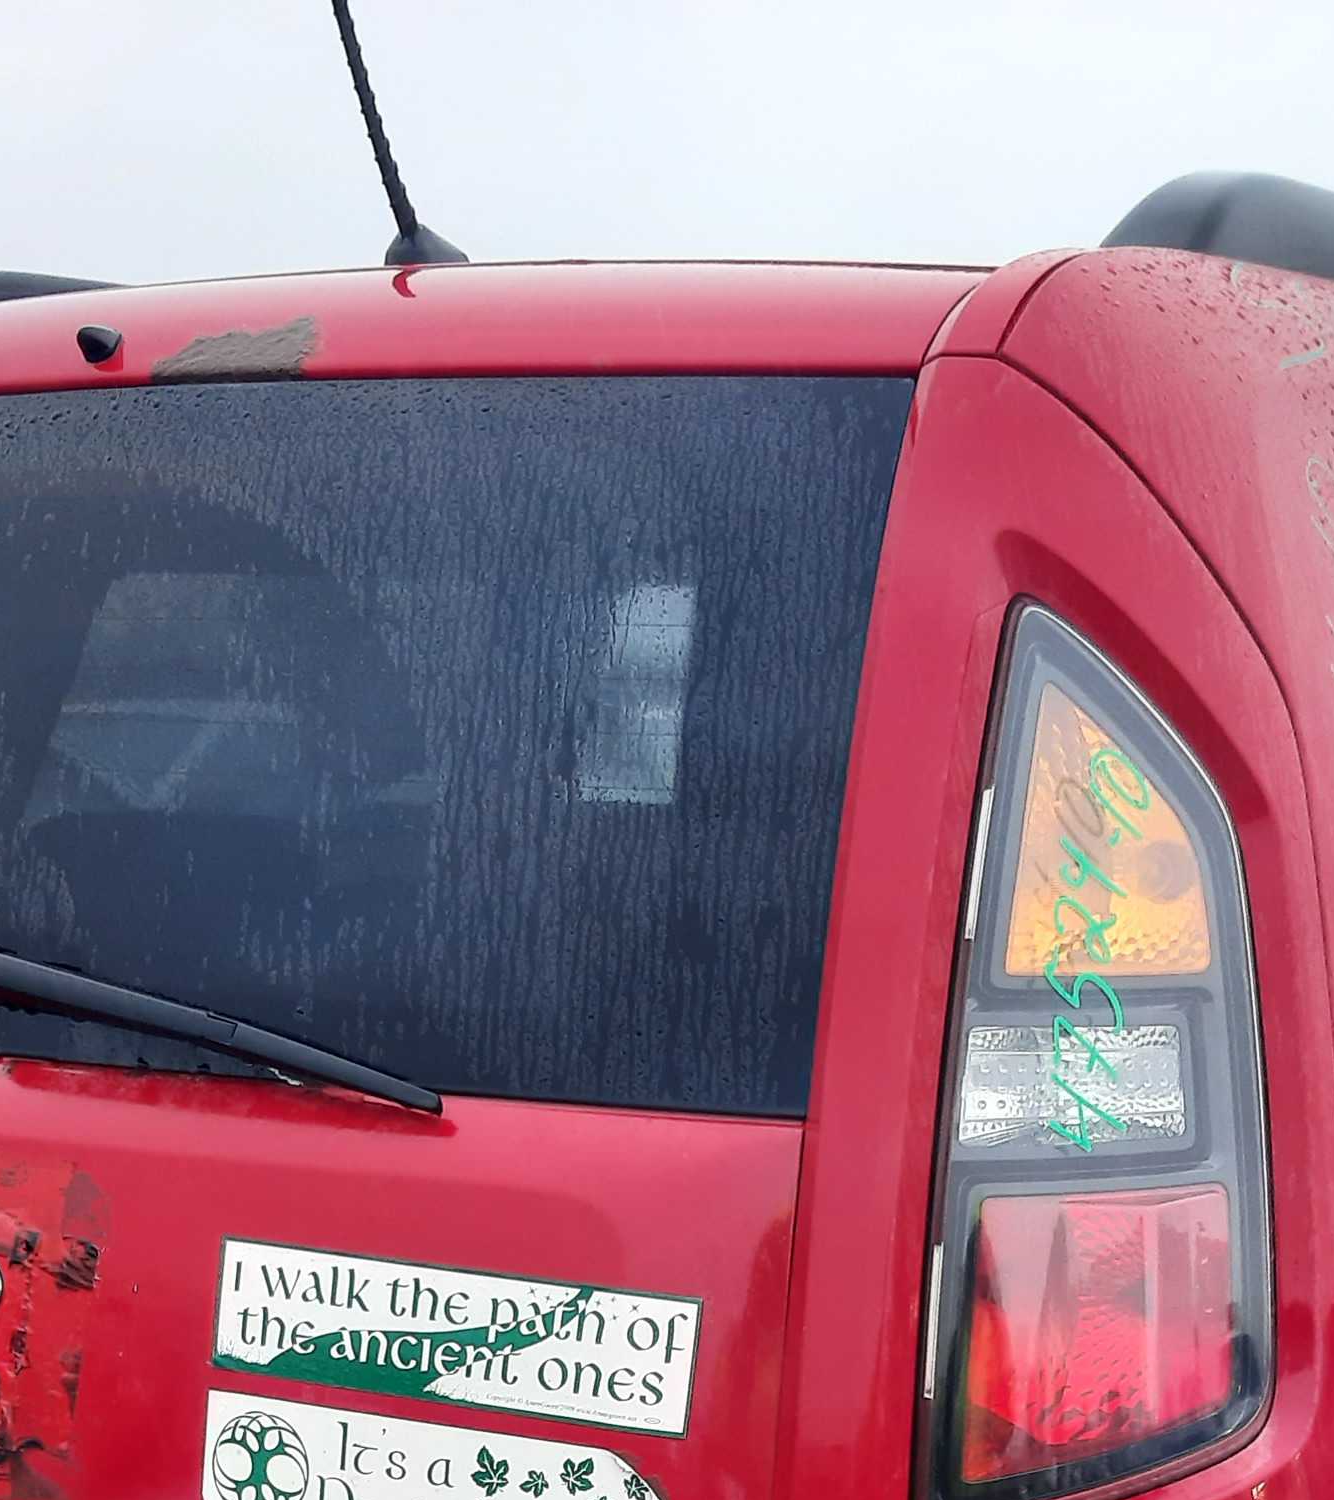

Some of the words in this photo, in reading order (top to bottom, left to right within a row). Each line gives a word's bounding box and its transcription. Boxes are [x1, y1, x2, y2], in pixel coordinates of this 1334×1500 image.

[233, 1261, 242, 1292] I
[386, 1277, 470, 1325] the
[487, 1298, 605, 1344] path
[626, 1313, 689, 1363] of
[237, 1306, 316, 1354] the
[330, 1327, 522, 1385] ancient
[537, 1357, 665, 1406] ones
[336, 1421, 408, 1481] It's
[427, 1457, 455, 1488] a
